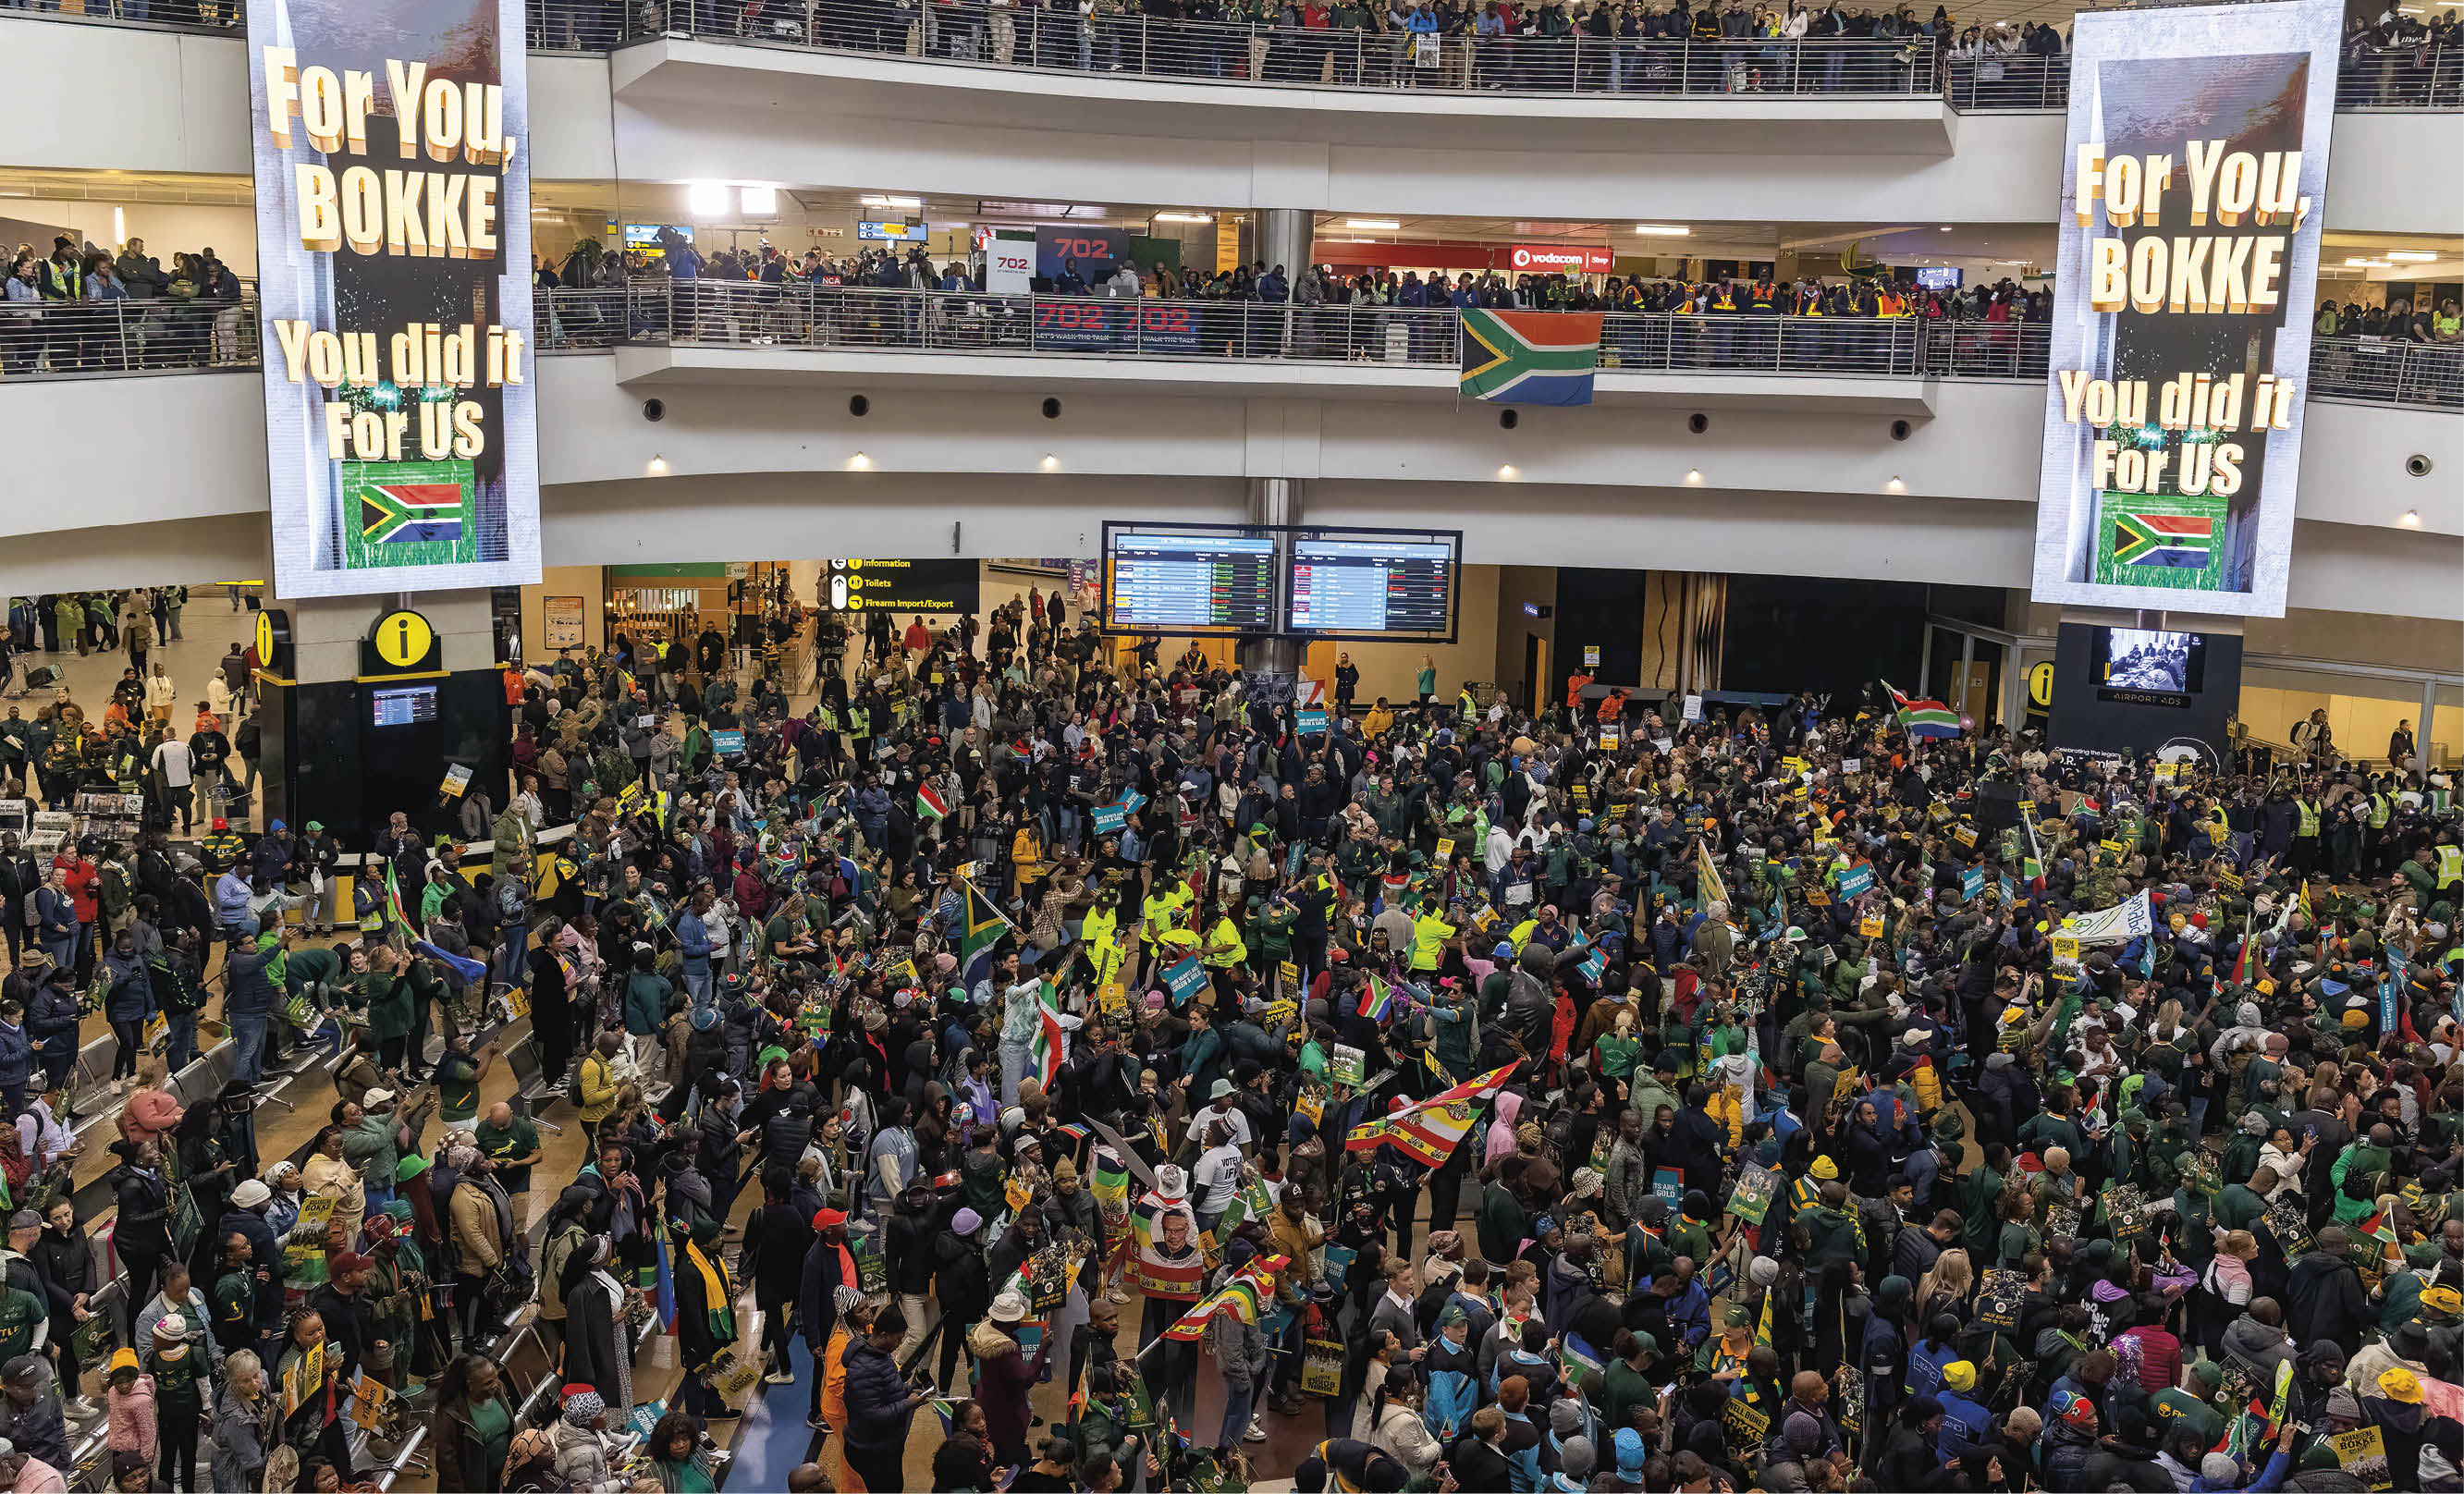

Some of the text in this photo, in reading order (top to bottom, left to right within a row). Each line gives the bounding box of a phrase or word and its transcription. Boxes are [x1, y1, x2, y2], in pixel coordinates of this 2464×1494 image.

[264, 44, 517, 175] For You,
[2075, 139, 2311, 234] For You,
[294, 162, 497, 261] BOKKE
[1532, 252, 1583, 264] vodacom
[2090, 235, 2286, 314] BOKKE
[274, 320, 524, 388] You did it
[2058, 370, 2296, 433] You did it
[325, 400, 485, 460] For US
[2092, 439, 2245, 497] For US
[863, 558, 911, 569] Information
[864, 579, 892, 588] Toilets
[865, 599, 954, 610] Firearm Import/Export
[2114, 692, 2182, 706] AIRPORT ADS
[716, 740, 740, 748] SCRUMS
[2054, 746, 2090, 756] Celebrating
[1172, 980, 1187, 993] GREEN
[1191, 971, 1203, 982] GOLD
[1179, 970, 1193, 983] HEARTS
[2384, 984, 2393, 1031] DELIVERED
[1265, 1010, 1296, 1024] BOKKE
[1656, 1189, 1675, 1198] GOLD
[305, 1203, 333, 1213] BOKKE
[635, 1410, 656, 1435] SCRUMS
[2340, 1435, 2376, 1451] BOKKE
